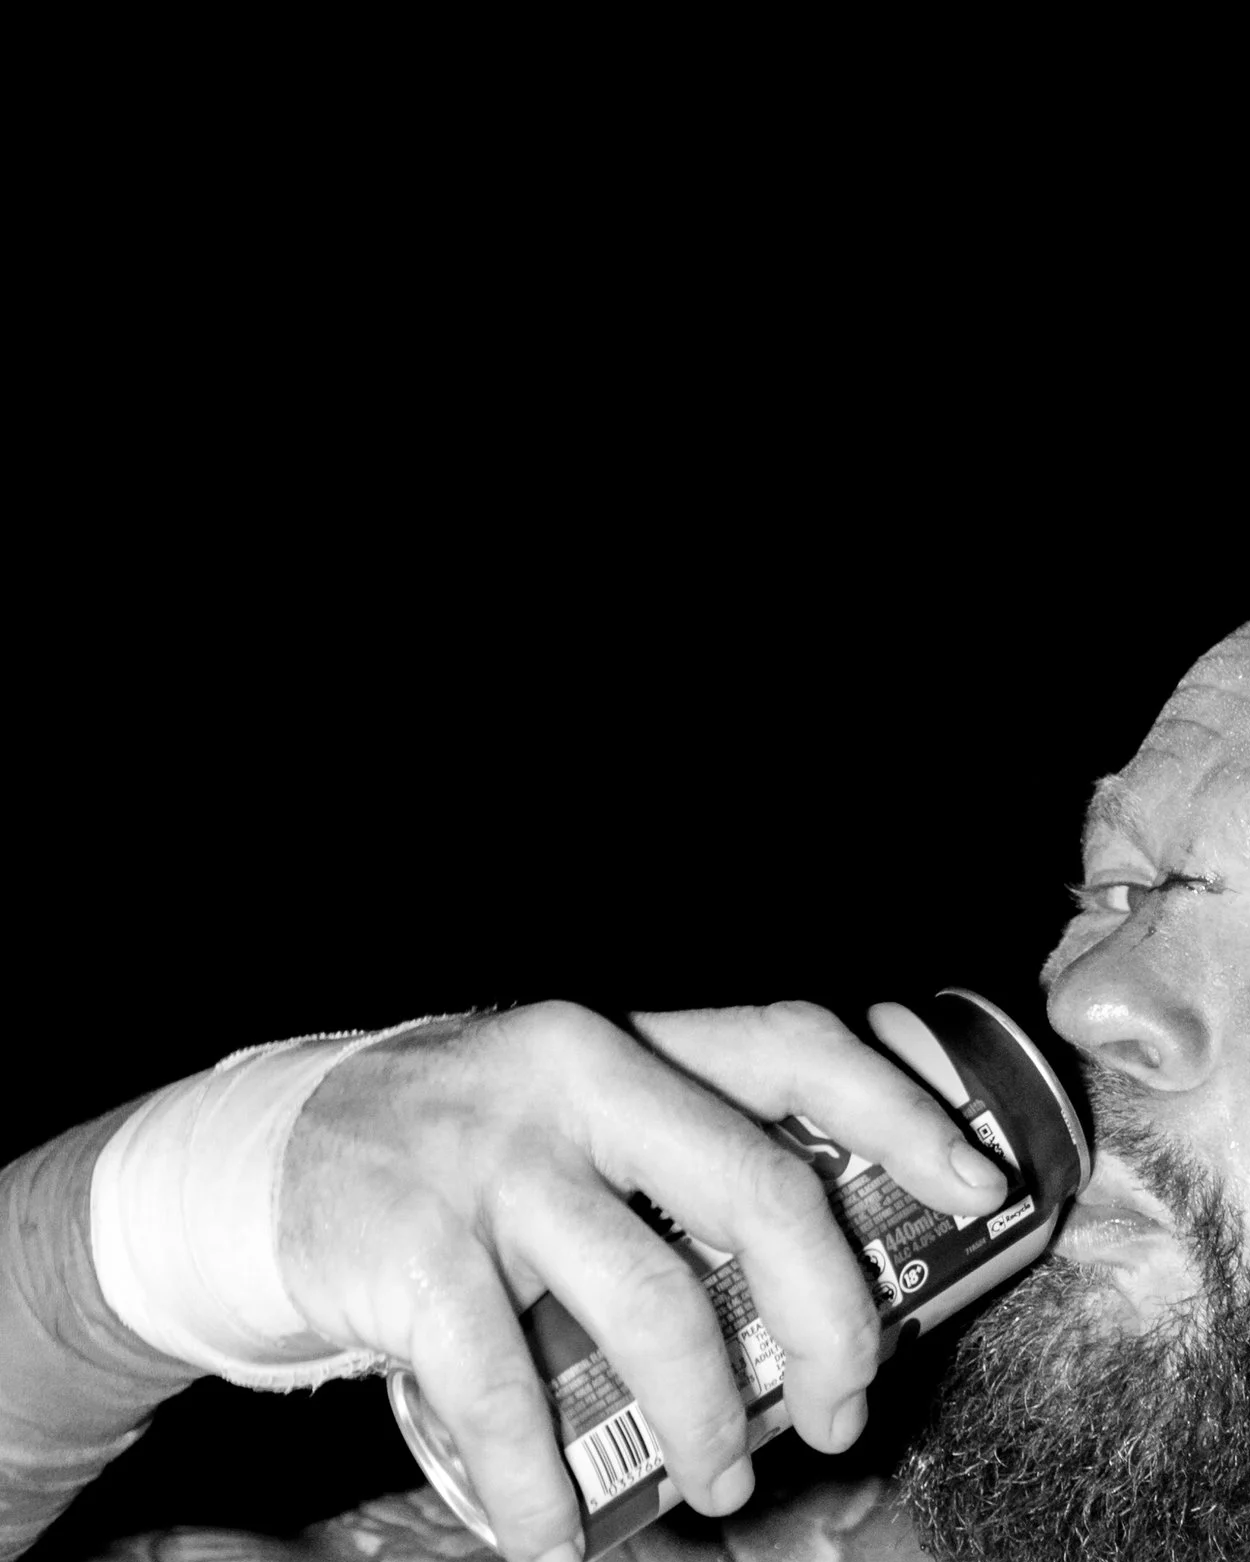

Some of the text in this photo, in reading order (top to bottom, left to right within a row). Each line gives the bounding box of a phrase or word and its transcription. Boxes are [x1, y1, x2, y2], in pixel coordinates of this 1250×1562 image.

[1006, 1202, 1031, 1222] Recycle
[886, 1209, 934, 1251] 440ml
[893, 1219, 954, 1266] ALC 4.0% VOL
[903, 1265, 922, 1289] 18+
[741, 1323, 764, 1341] PLEA
